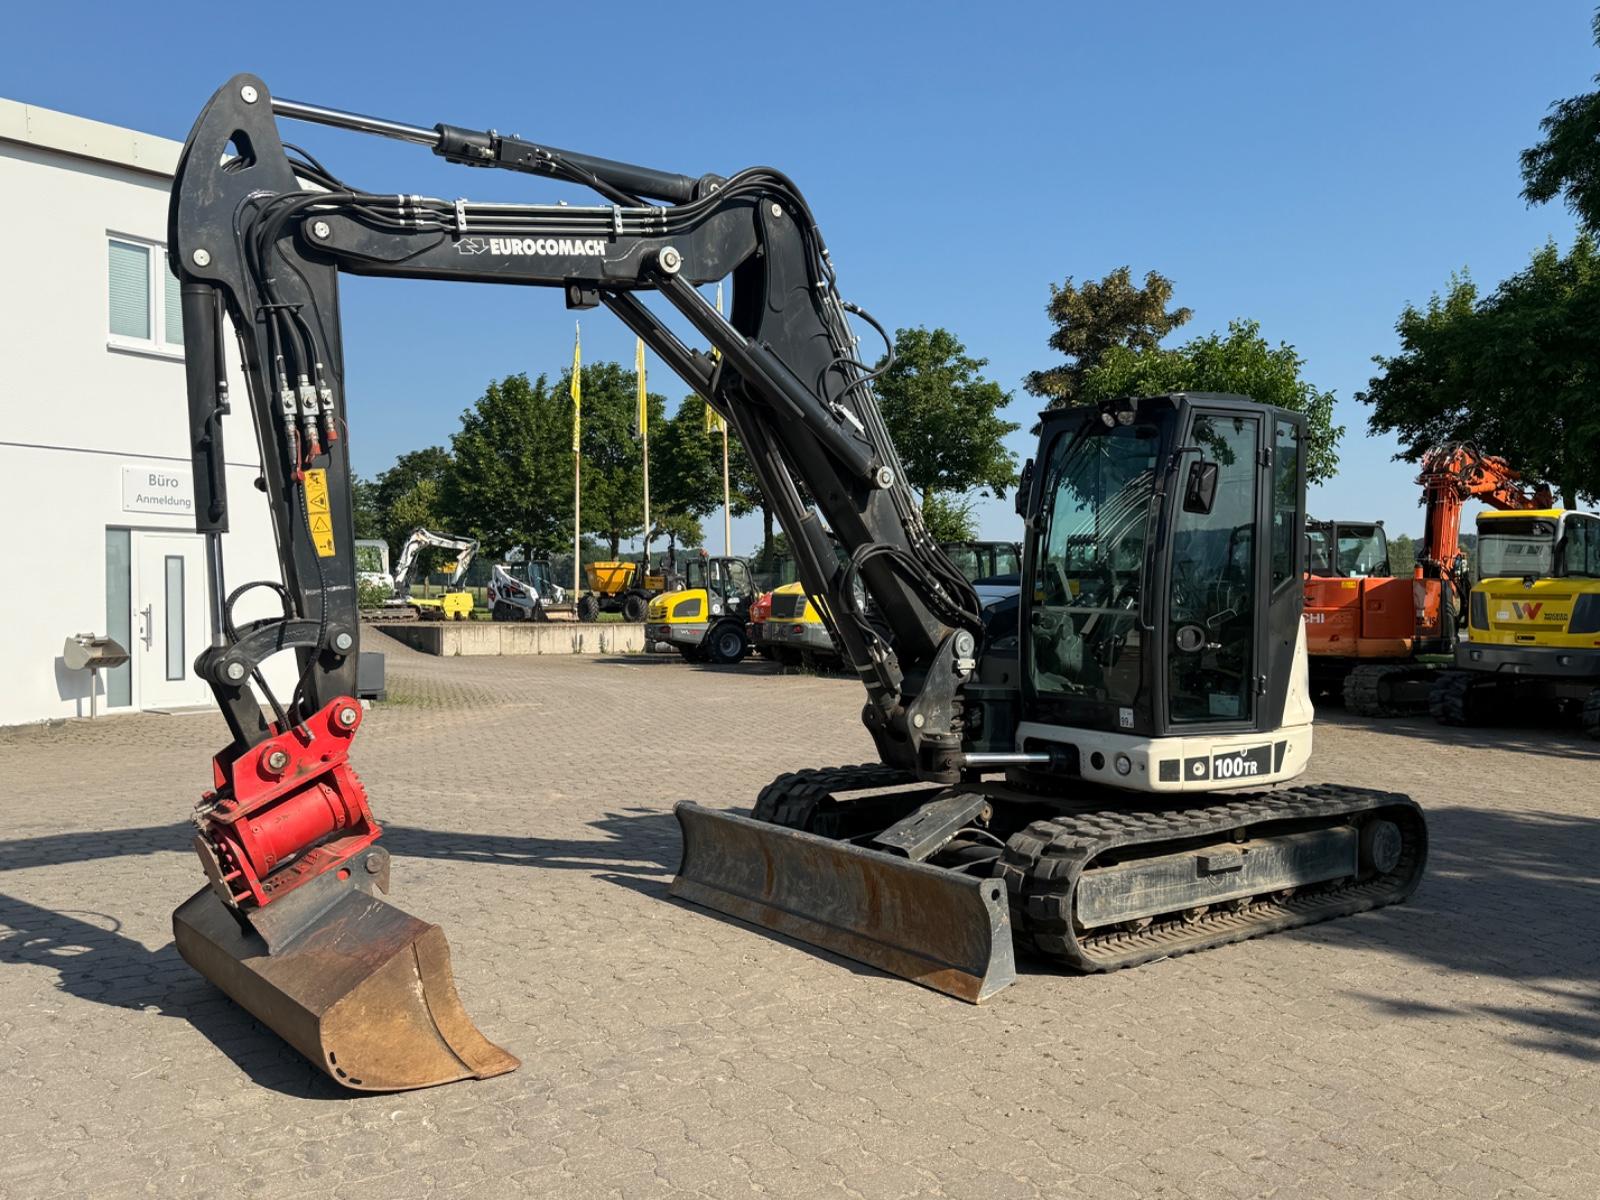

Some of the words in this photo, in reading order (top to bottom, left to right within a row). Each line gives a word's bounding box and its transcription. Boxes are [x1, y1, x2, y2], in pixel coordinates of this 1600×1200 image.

[490, 238, 606, 256] EUROCOMACH
[149, 473, 179, 488] Büro
[136, 493, 191, 509] Anmeldung
[1215, 757, 1258, 778] 100TR
